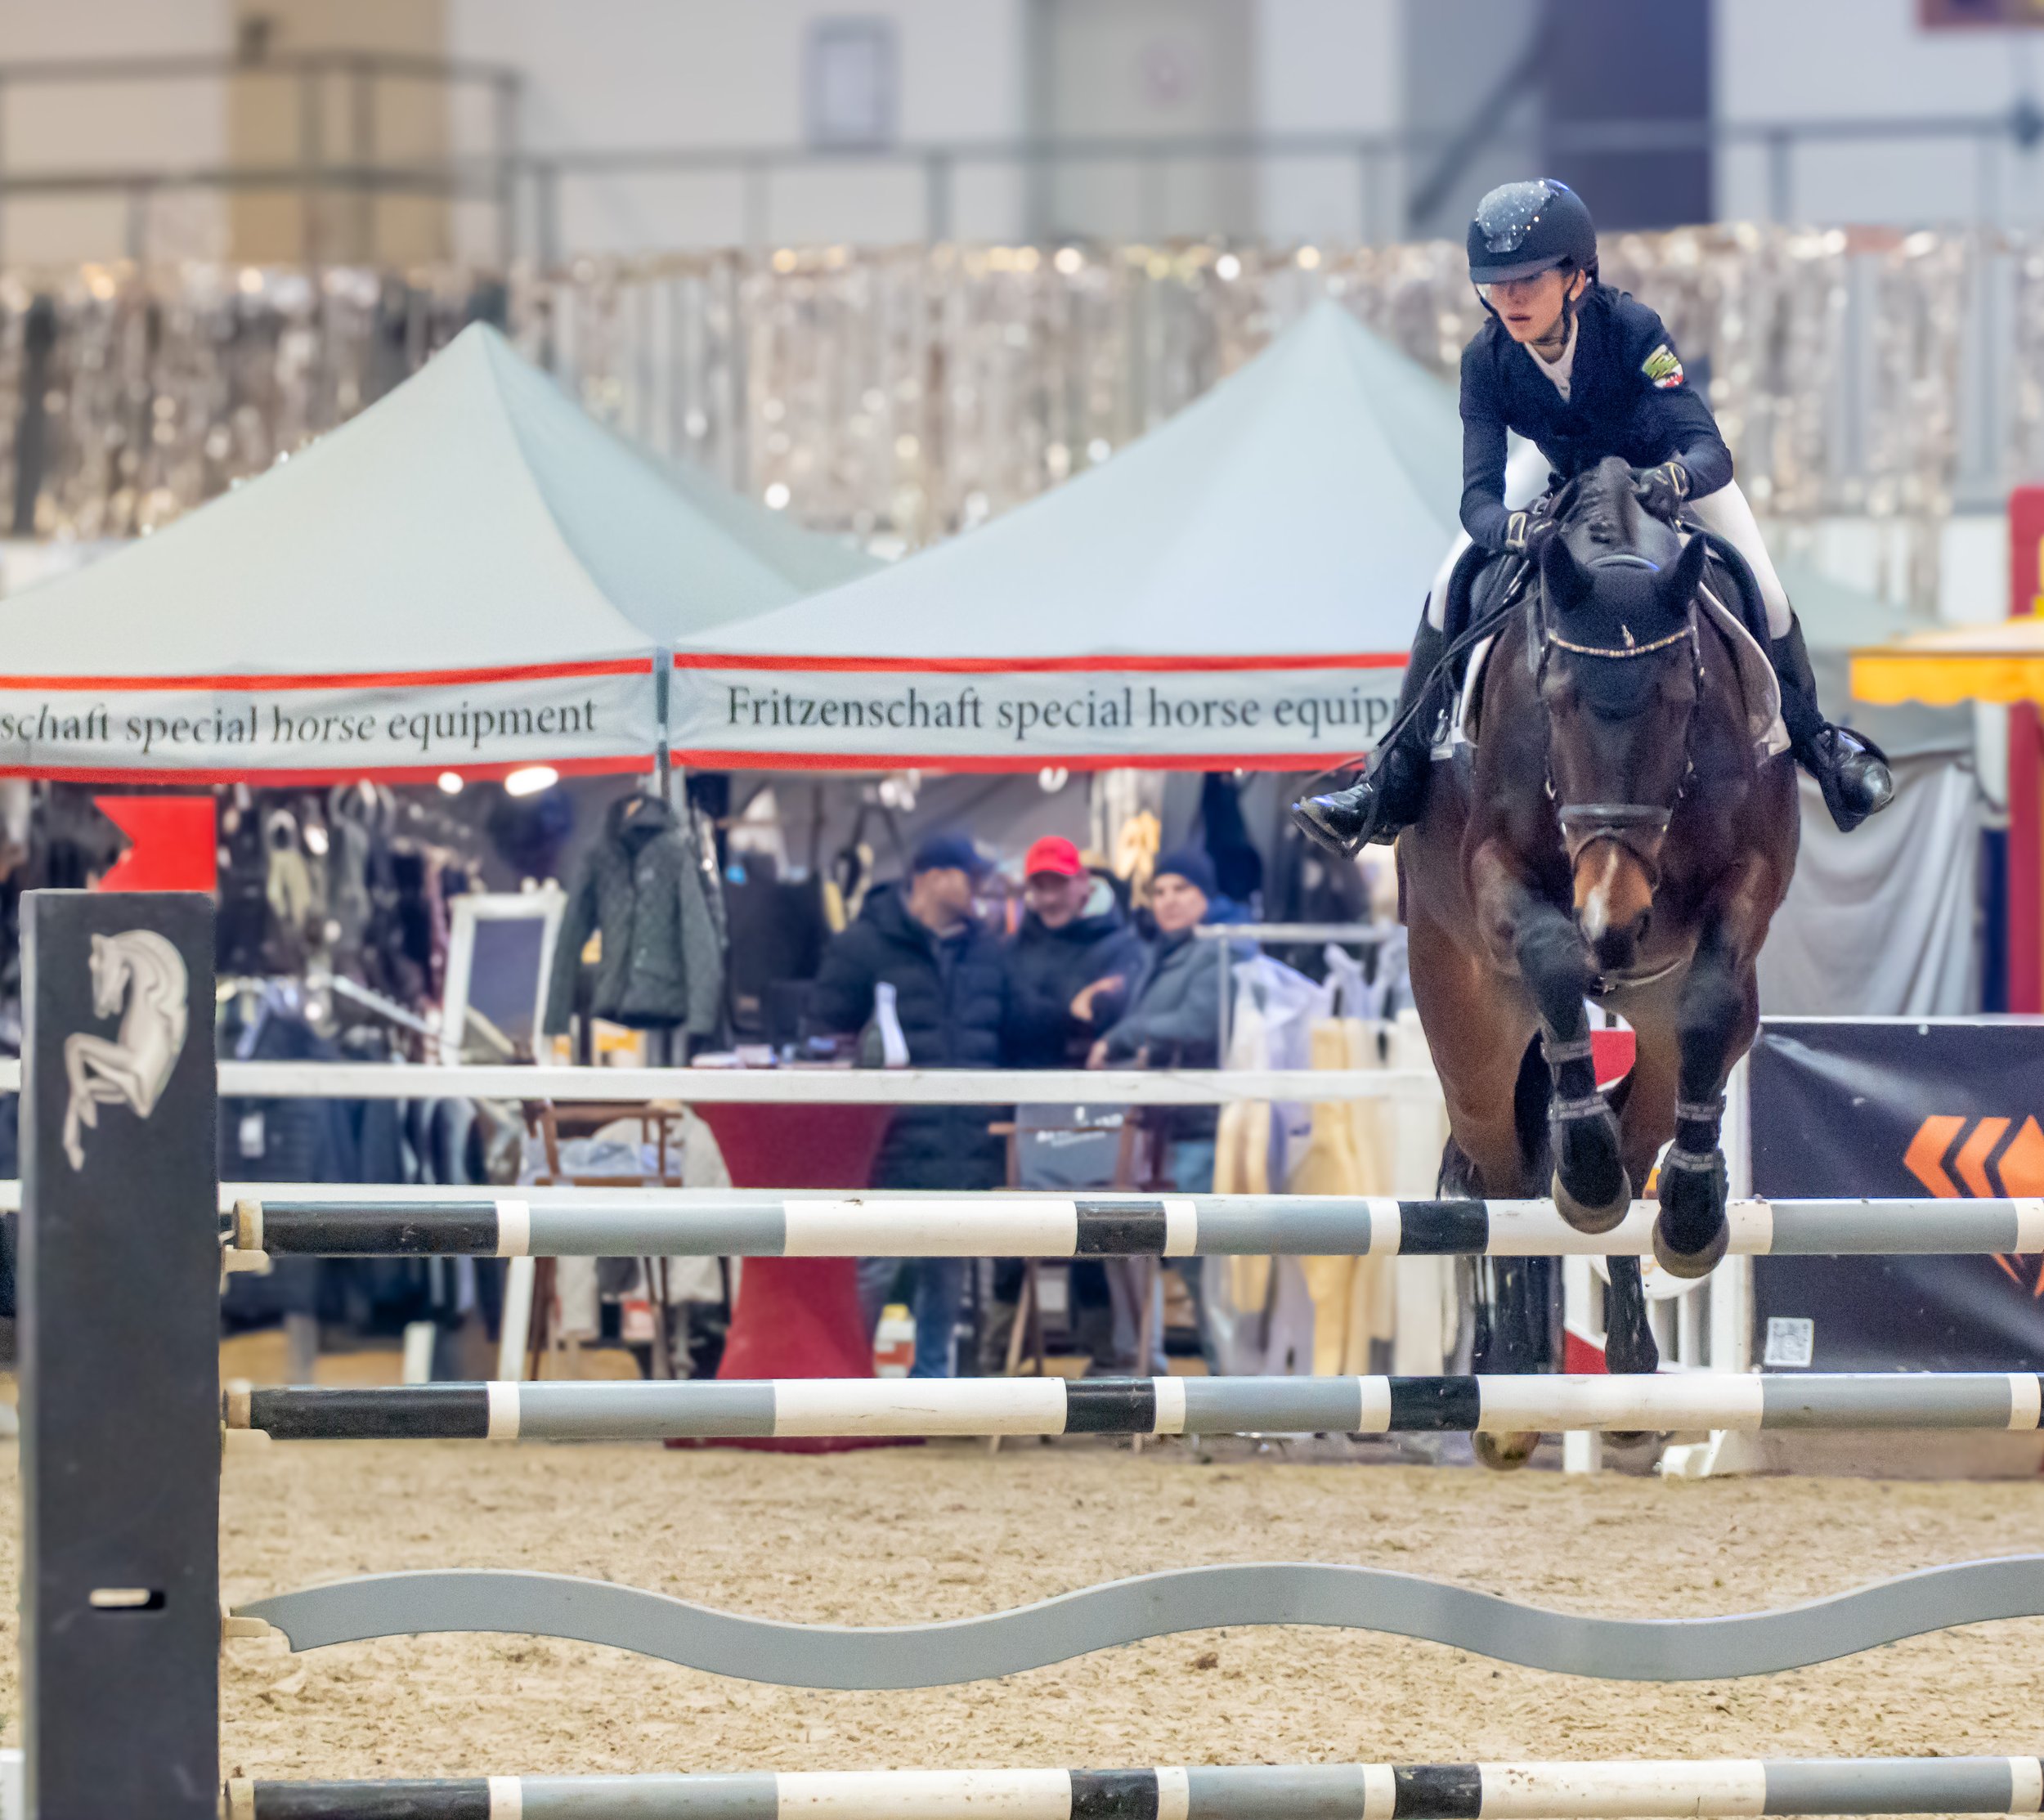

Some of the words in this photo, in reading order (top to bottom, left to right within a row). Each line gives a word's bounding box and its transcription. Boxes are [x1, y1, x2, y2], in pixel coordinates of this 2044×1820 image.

[126, 706, 259, 755] special
[272, 705, 377, 742] horse
[388, 698, 598, 751] equipment
[727, 685, 983, 728] Fritzenschaft
[997, 687, 1133, 741] special
[1147, 687, 1260, 728] horse
